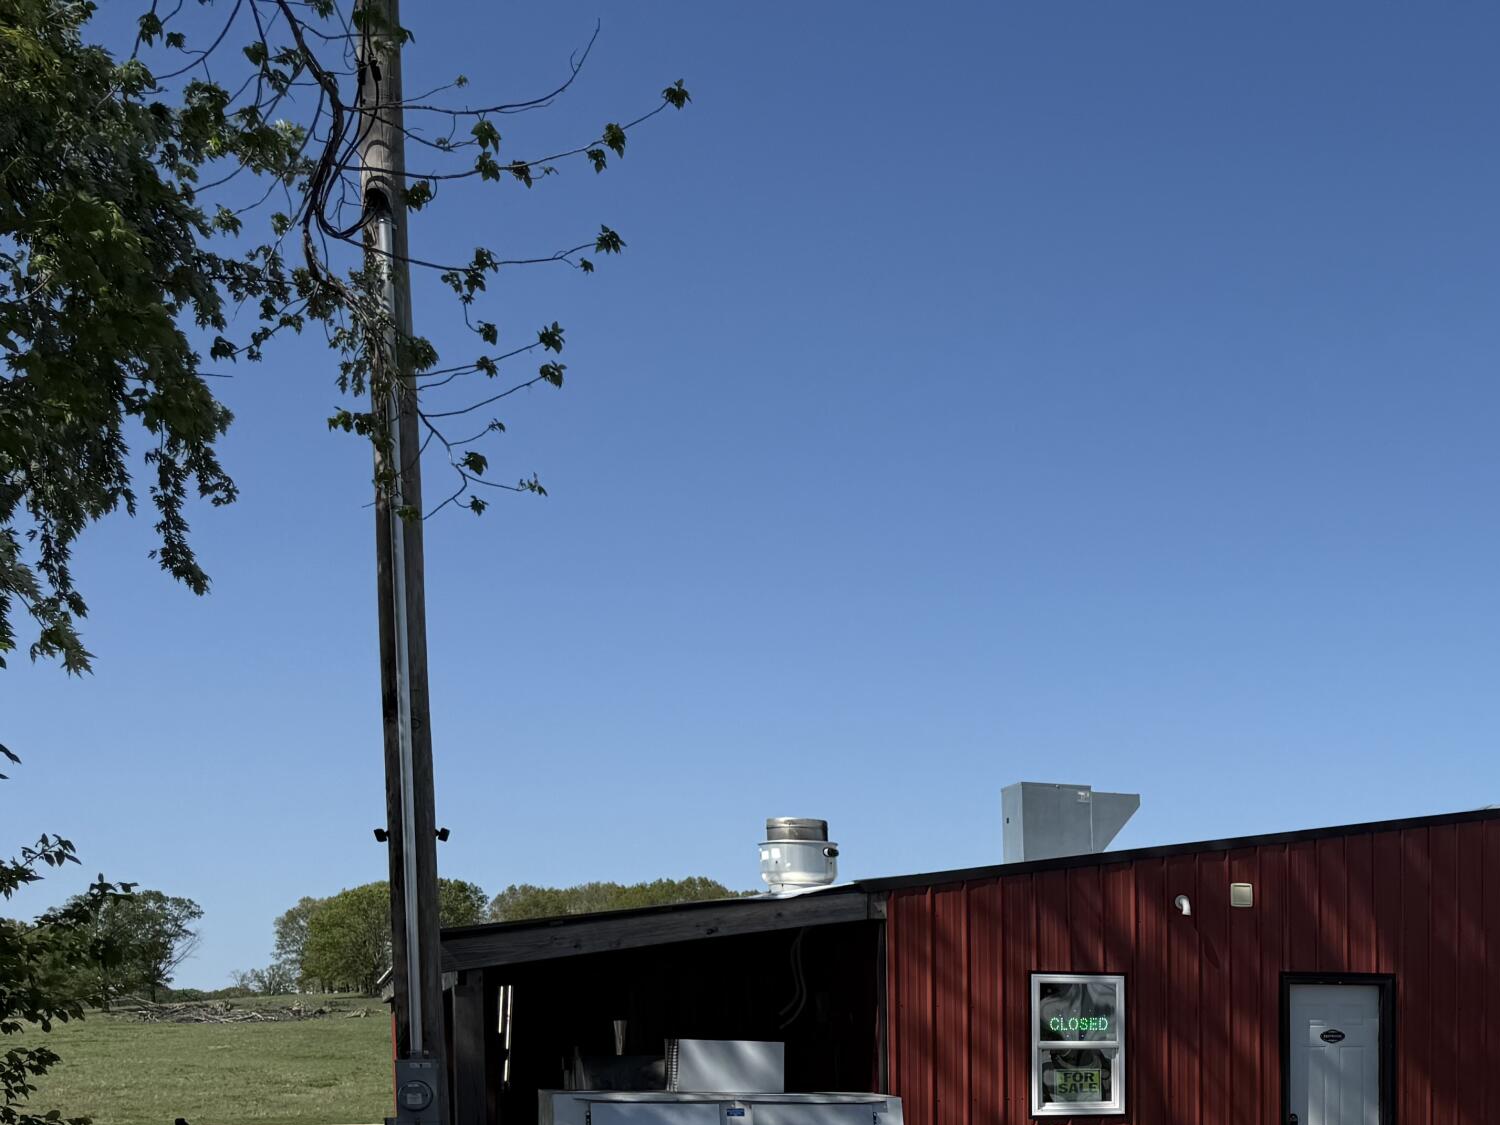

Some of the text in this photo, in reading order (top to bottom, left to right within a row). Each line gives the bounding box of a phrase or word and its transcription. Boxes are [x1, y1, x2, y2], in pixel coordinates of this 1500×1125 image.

[1050, 1017, 1108, 1031] CLOSED
[1063, 1072, 1095, 1083] FOR
[1058, 1083, 1098, 1094] SALE
